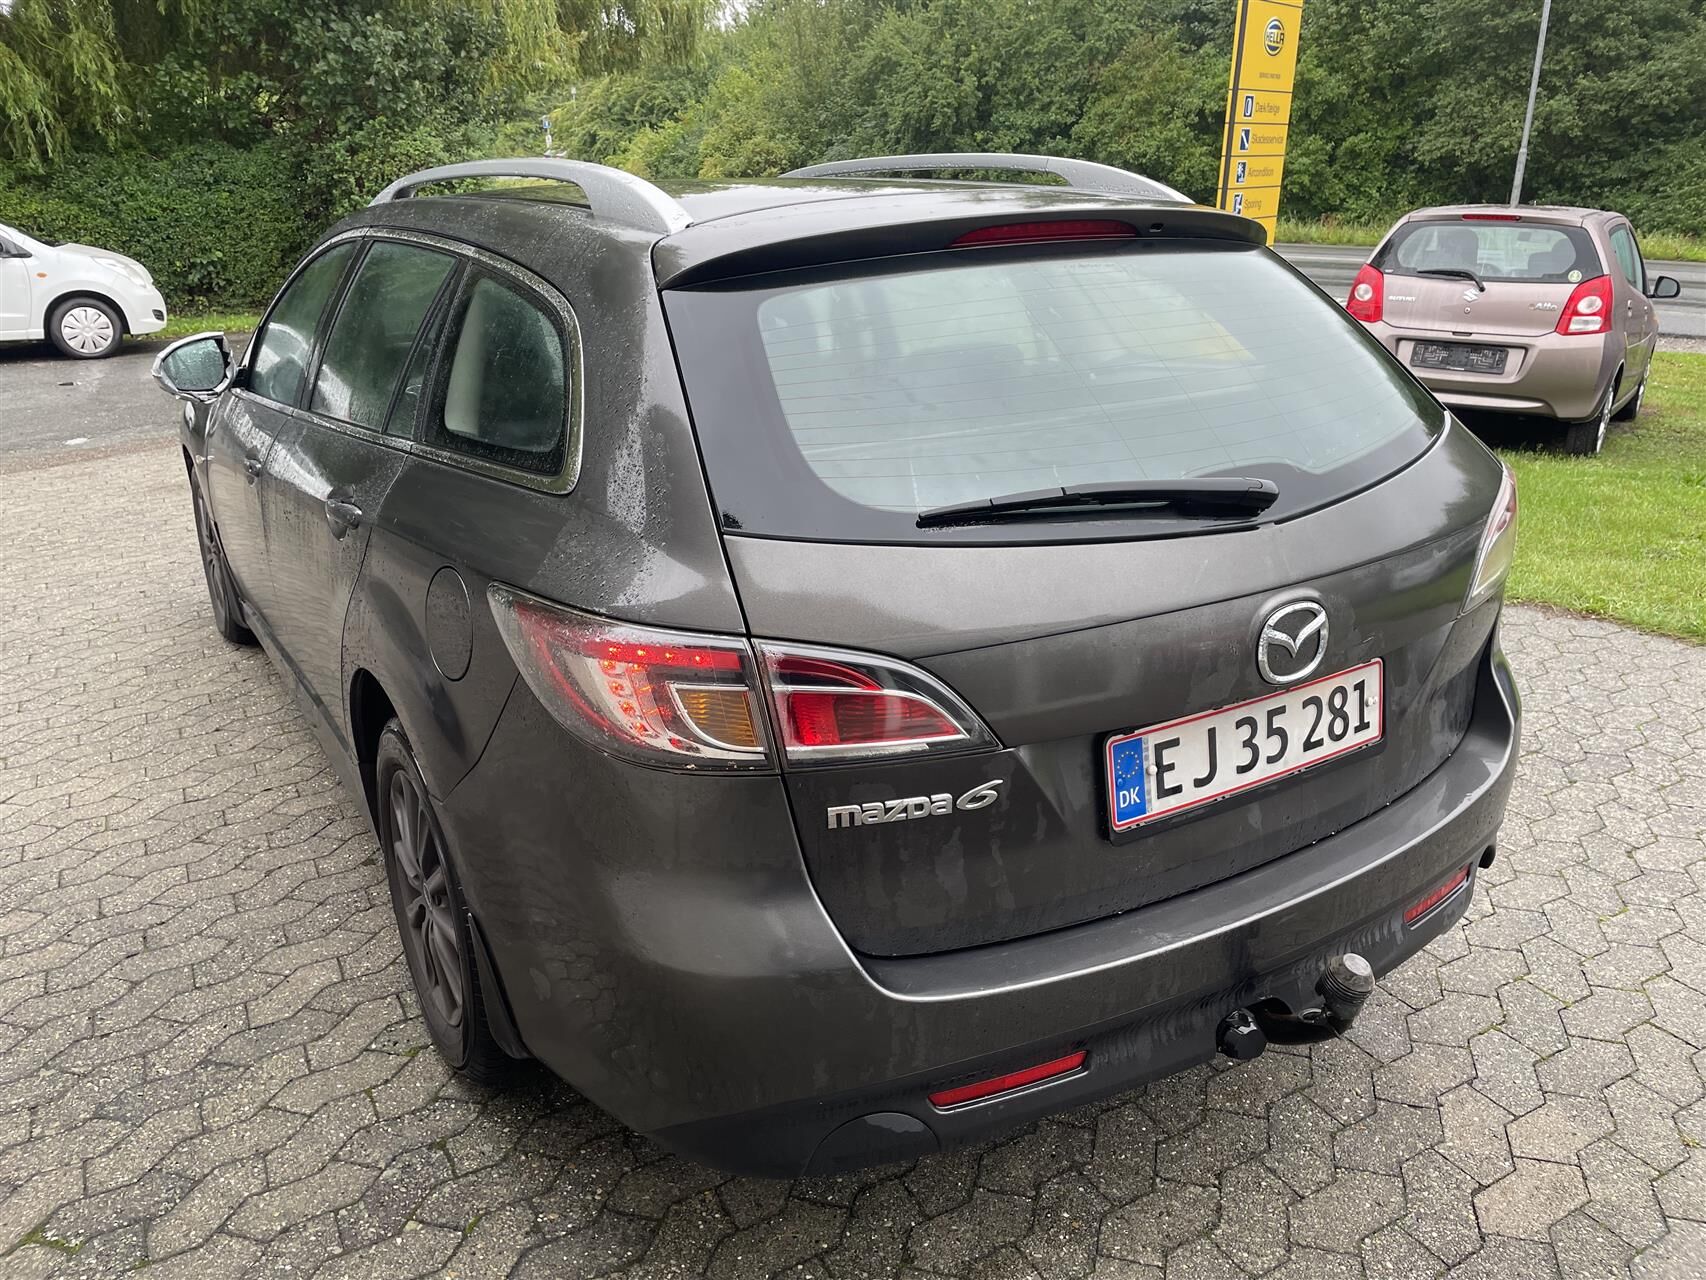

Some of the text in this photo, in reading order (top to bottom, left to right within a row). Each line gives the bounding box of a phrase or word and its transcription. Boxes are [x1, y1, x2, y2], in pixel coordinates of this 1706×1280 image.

[1154, 679, 1370, 800] EJ 35 281
[1119, 786, 1141, 809] DK
